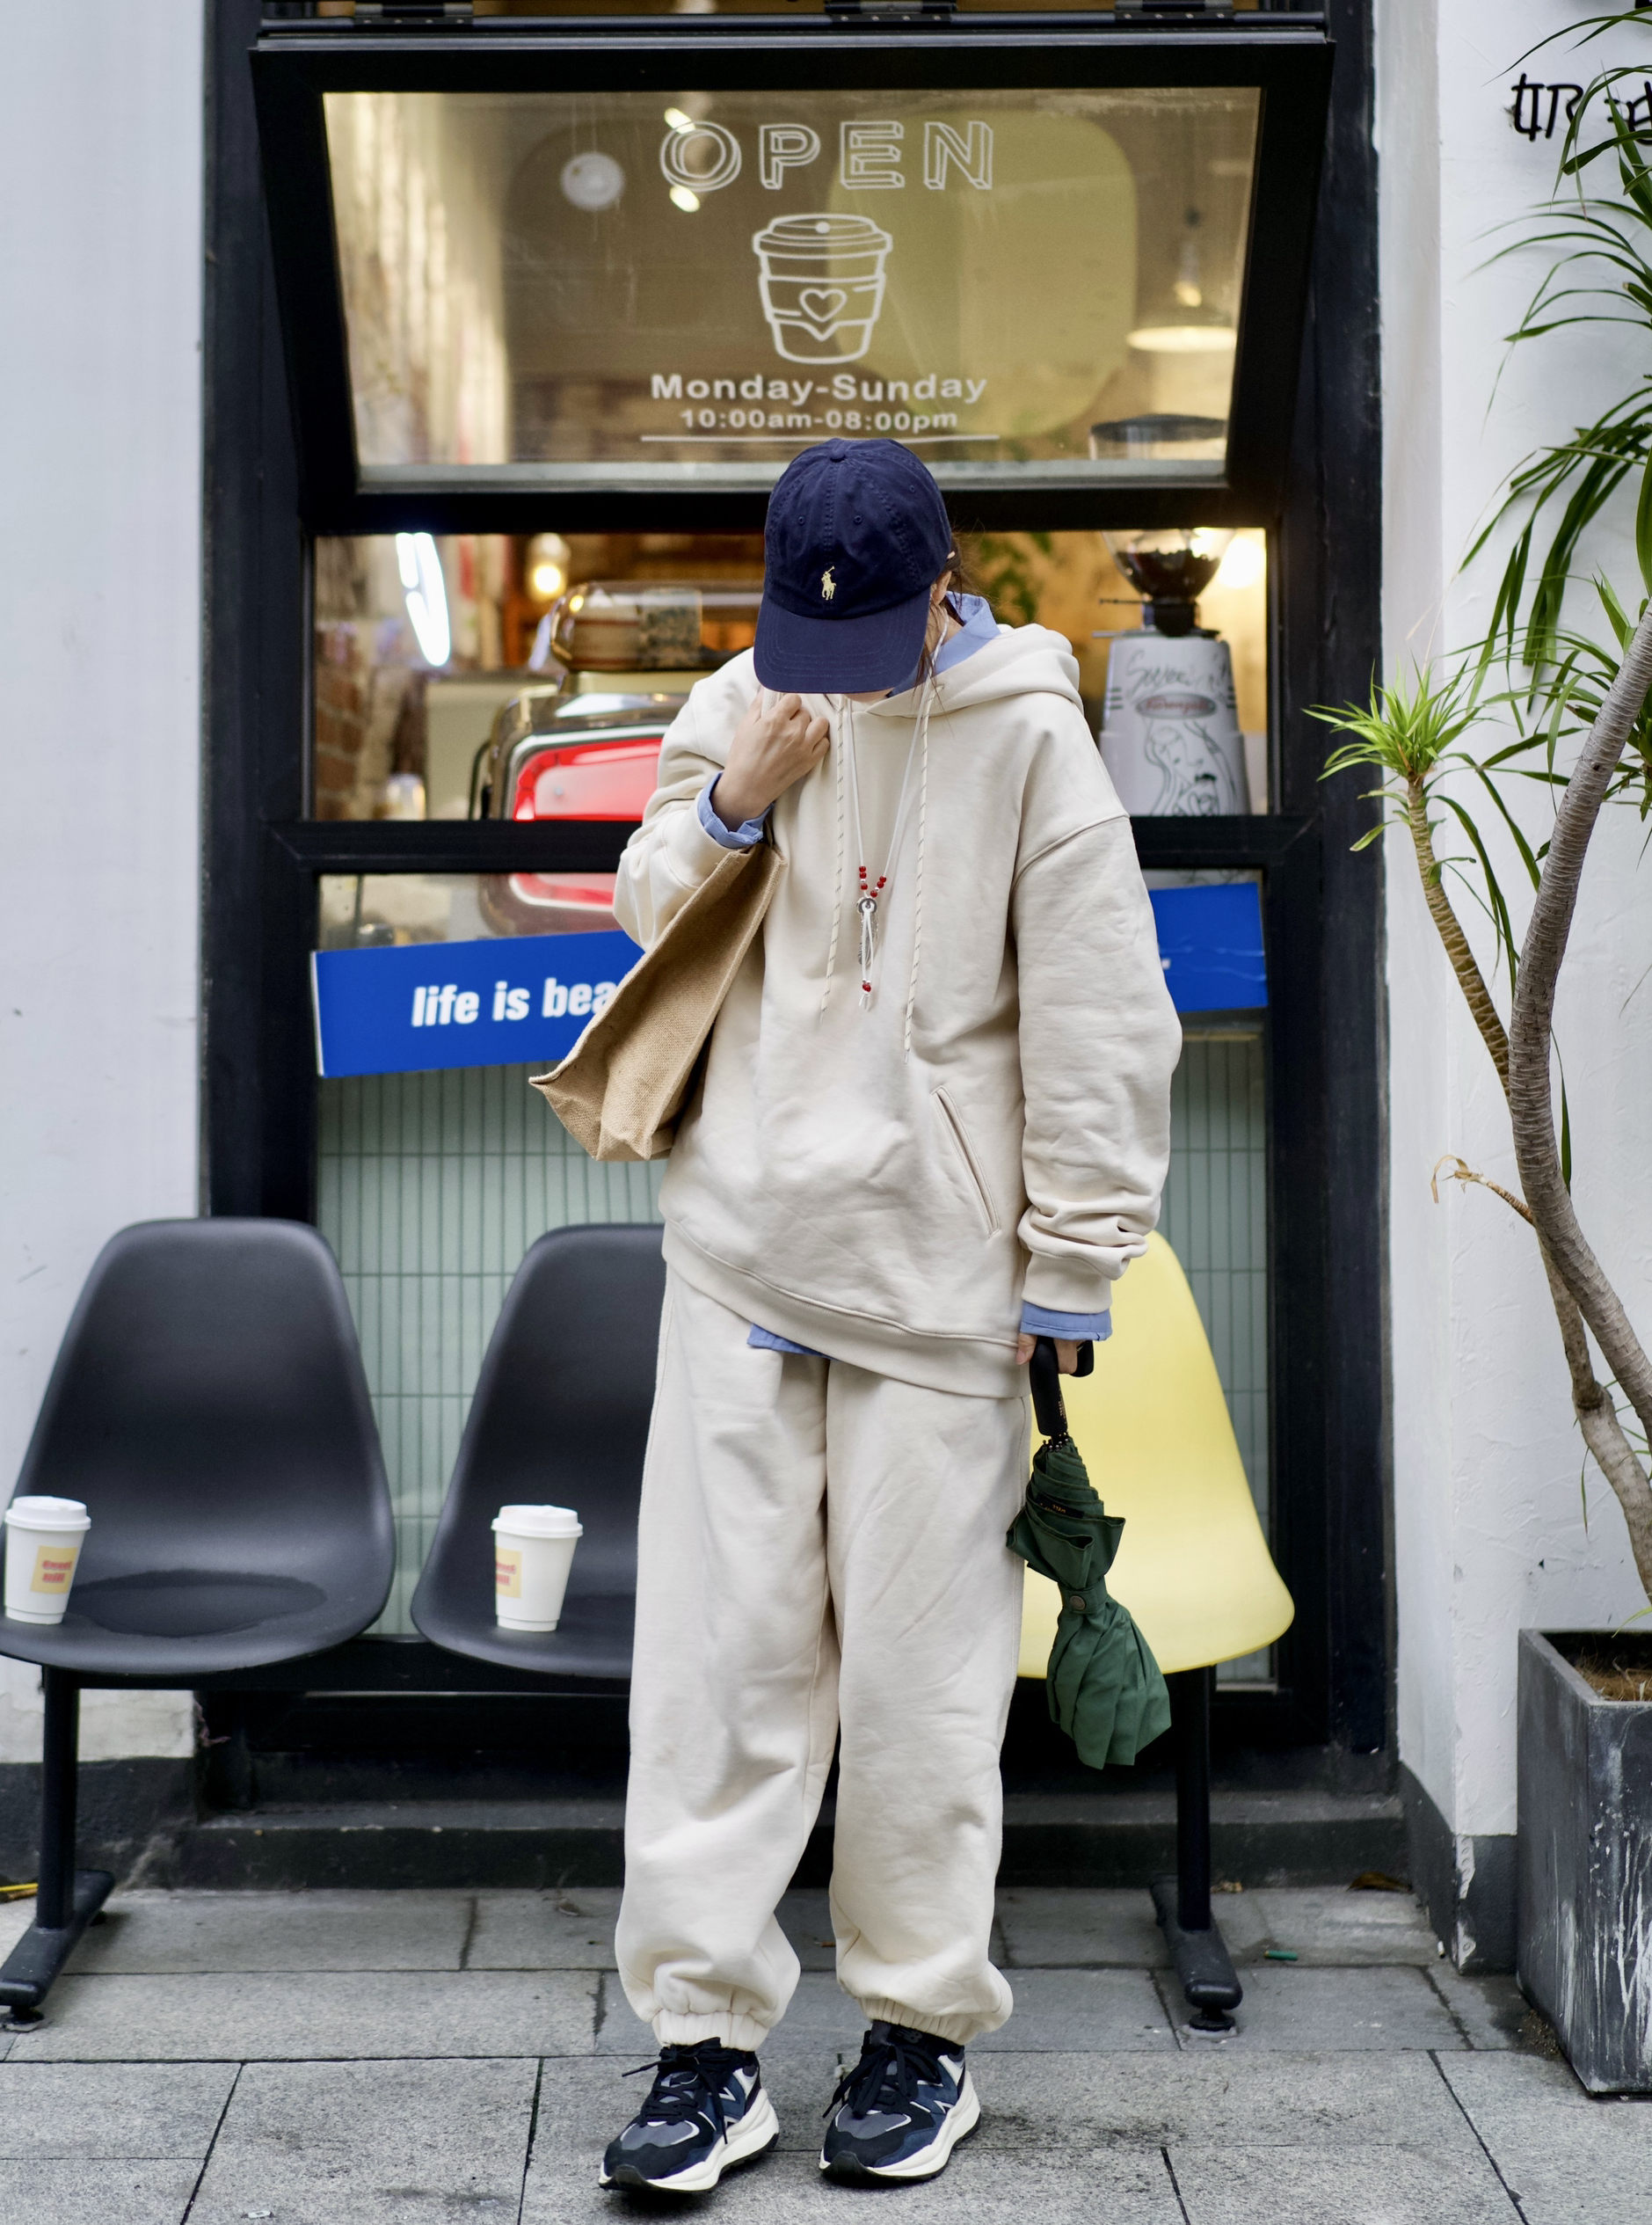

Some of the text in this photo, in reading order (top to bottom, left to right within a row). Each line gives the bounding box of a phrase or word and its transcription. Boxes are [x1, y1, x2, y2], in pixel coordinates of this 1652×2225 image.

[660, 120, 993, 192] OPEN
[651, 374, 987, 406] Monday-Sunday
[680, 410, 958, 434] 10:00am-08:00pm
[411, 983, 480, 1027] life
[492, 981, 529, 1021] is
